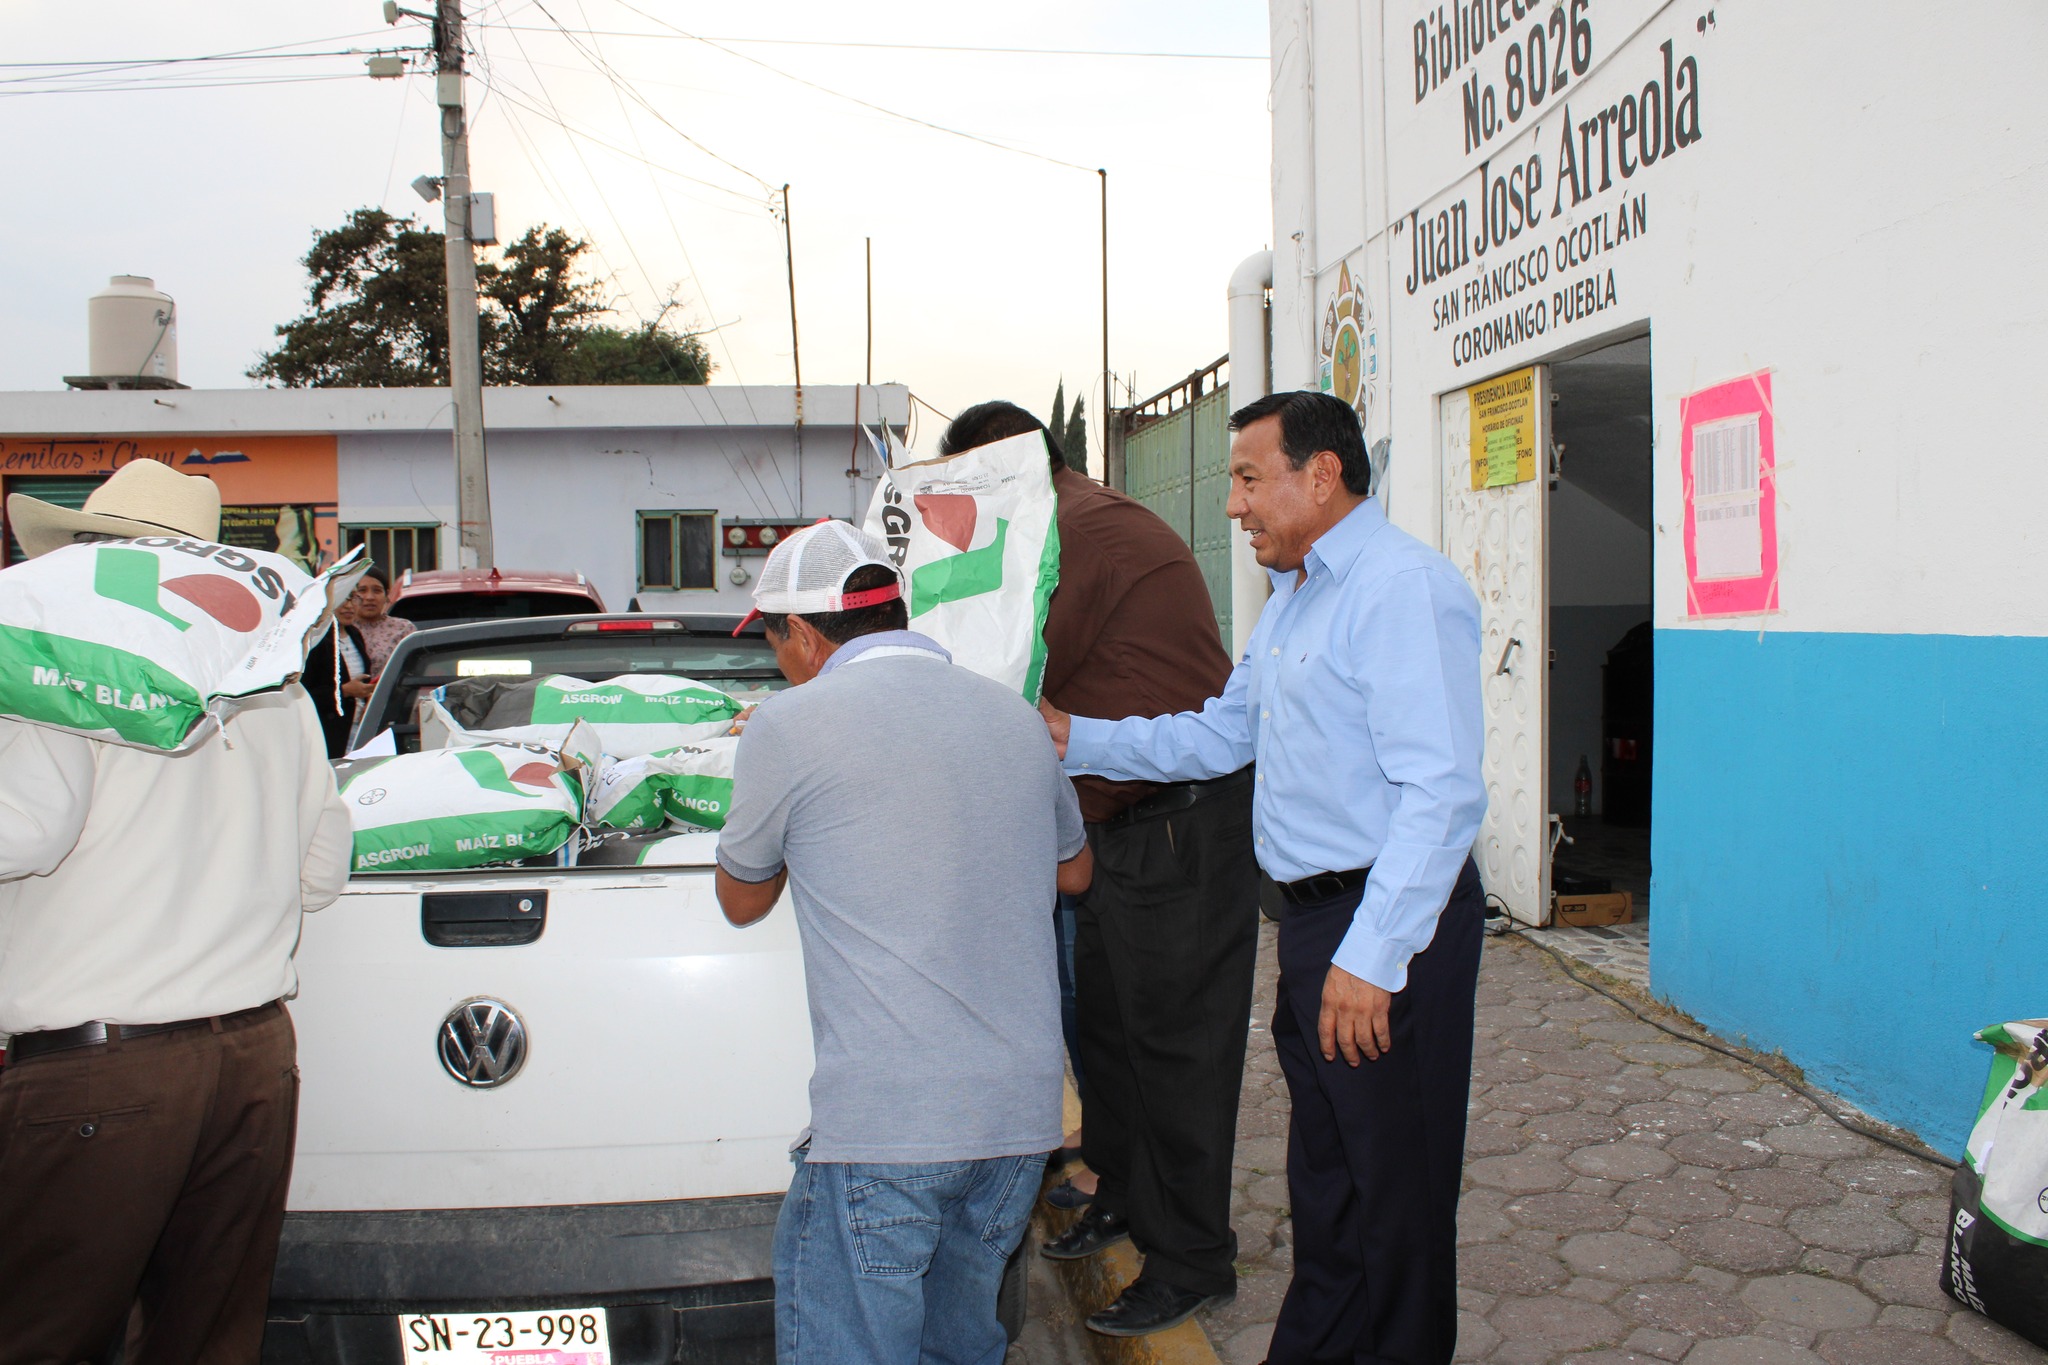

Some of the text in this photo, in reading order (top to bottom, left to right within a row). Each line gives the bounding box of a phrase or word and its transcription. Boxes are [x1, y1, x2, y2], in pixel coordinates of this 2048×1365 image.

[1413, 0, 1541, 105] Bibliote
[1474, 126, 1543, 257] José
[1433, 189, 1647, 332] SAN FRANCISCO OCOTLÁN
[1453, 268, 1618, 368] CORONANGO PUEBLA
[1473, 376, 1532, 409] PRESIDENCIA AUXILIAR
[560, 693, 623, 705] ASGROW
[357, 843, 430, 869] ASGROW
[456, 833, 501, 852] MAÍZ
[1951, 1207, 1976, 1304] BLANCO
[409, 1314, 598, 1352] SN-23-998
